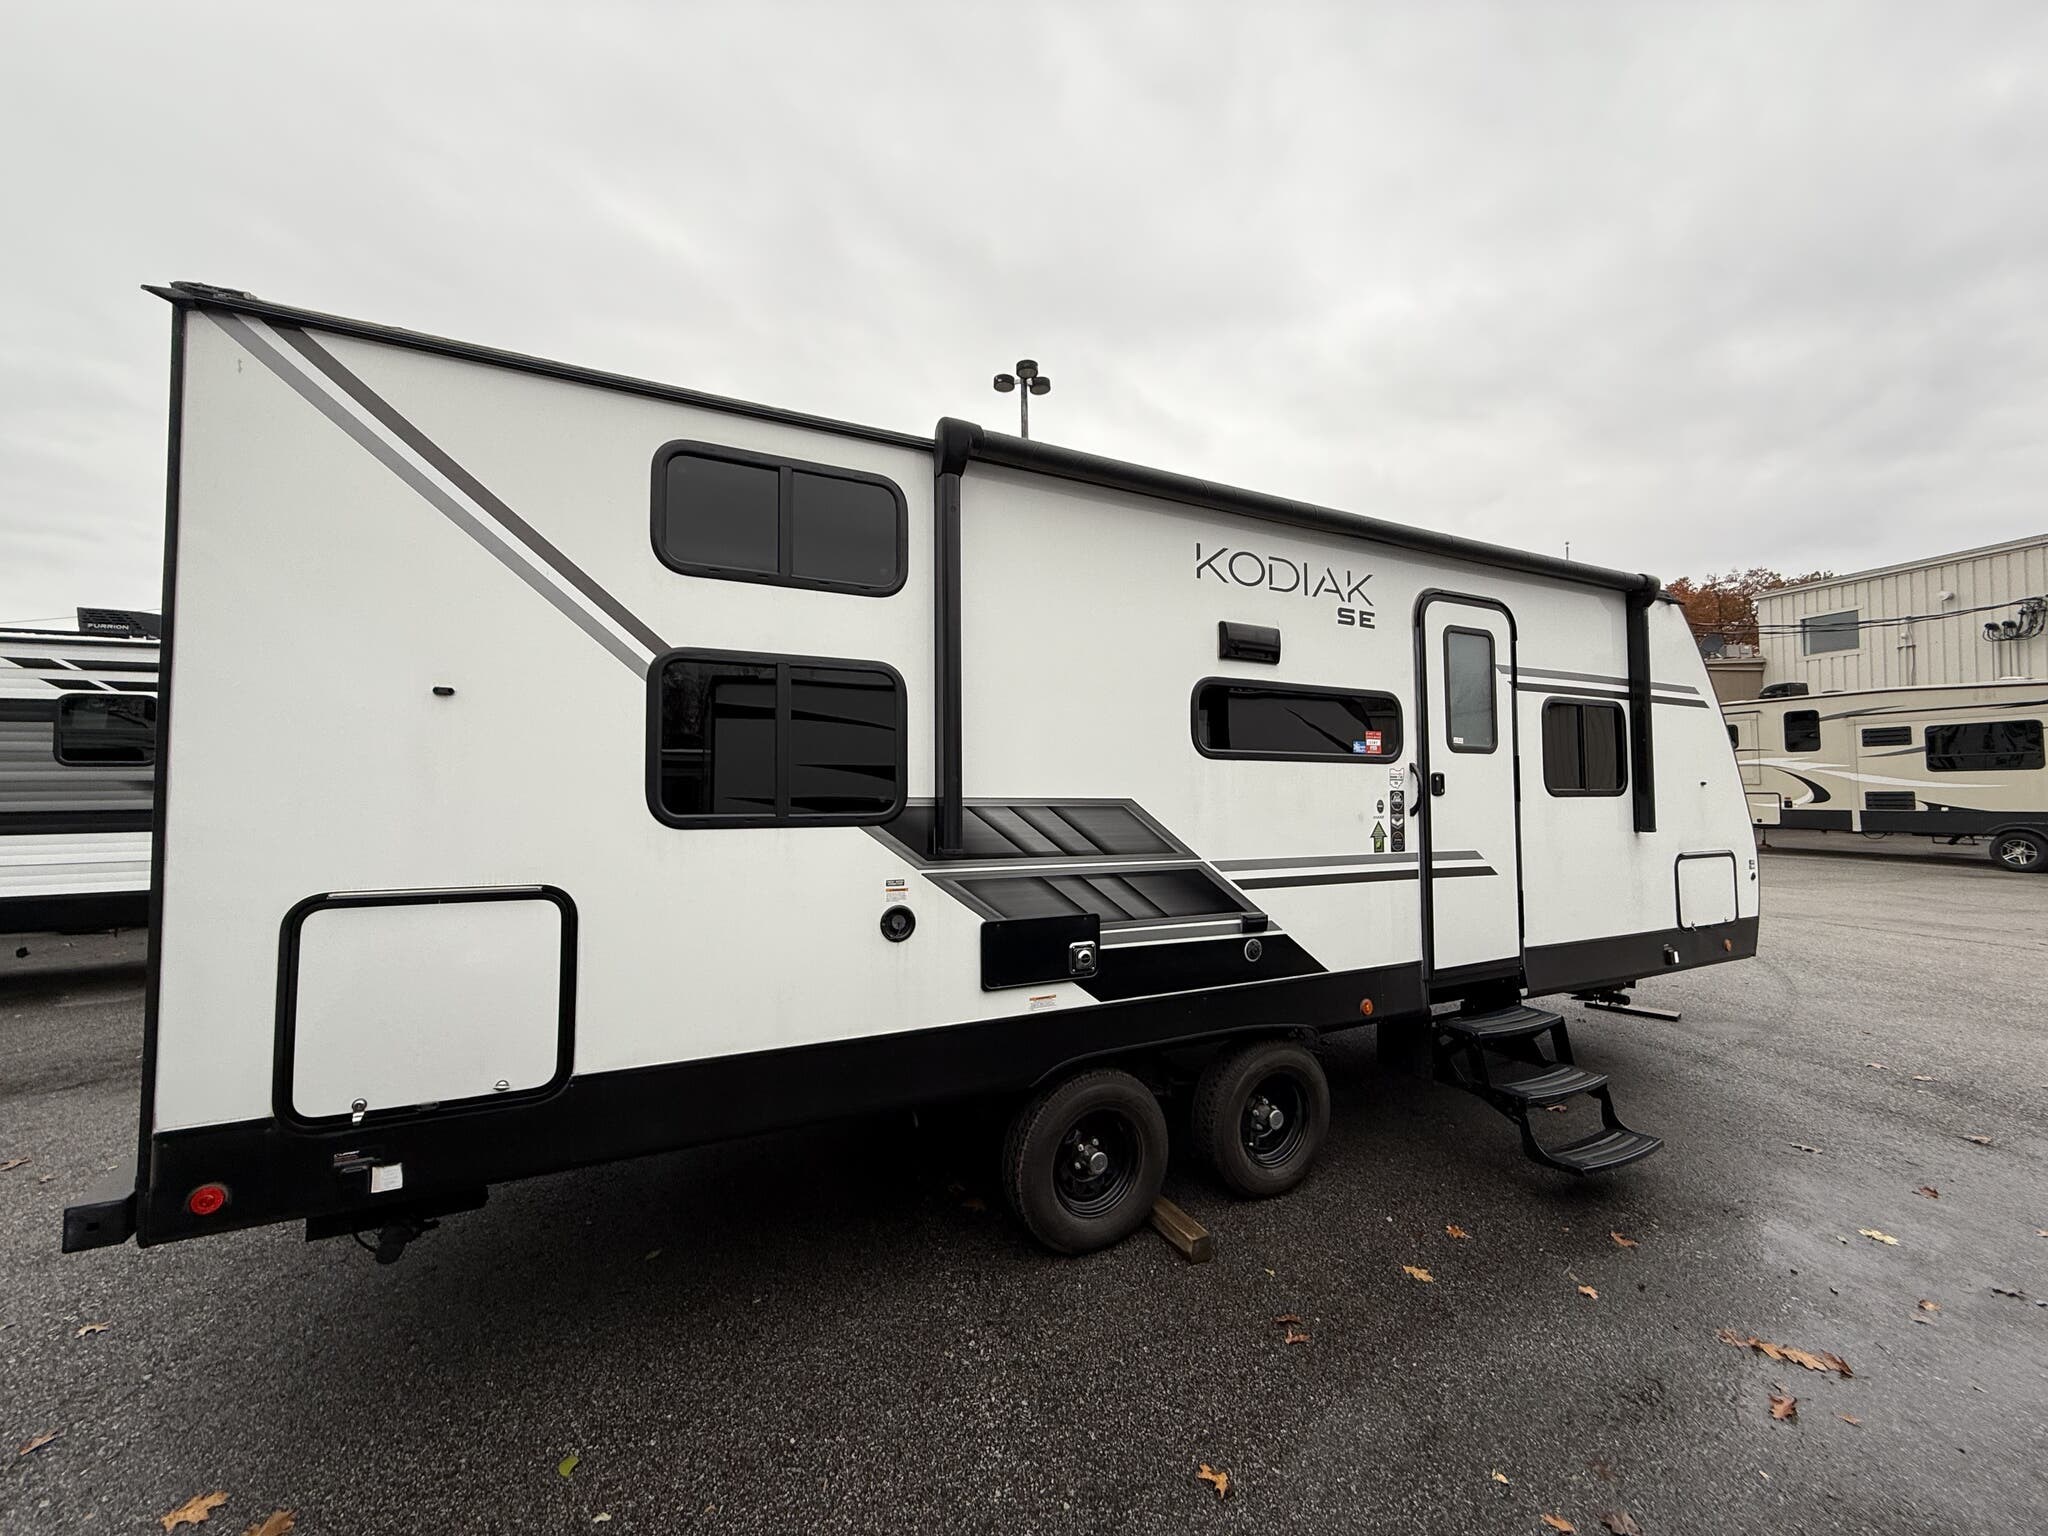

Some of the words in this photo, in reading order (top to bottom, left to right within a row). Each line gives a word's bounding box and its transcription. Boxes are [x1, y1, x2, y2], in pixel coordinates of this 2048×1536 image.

[1196, 542, 1375, 607] KODIAK
[87, 622, 130, 631] FURRION
[1337, 607, 1376, 630] SE
